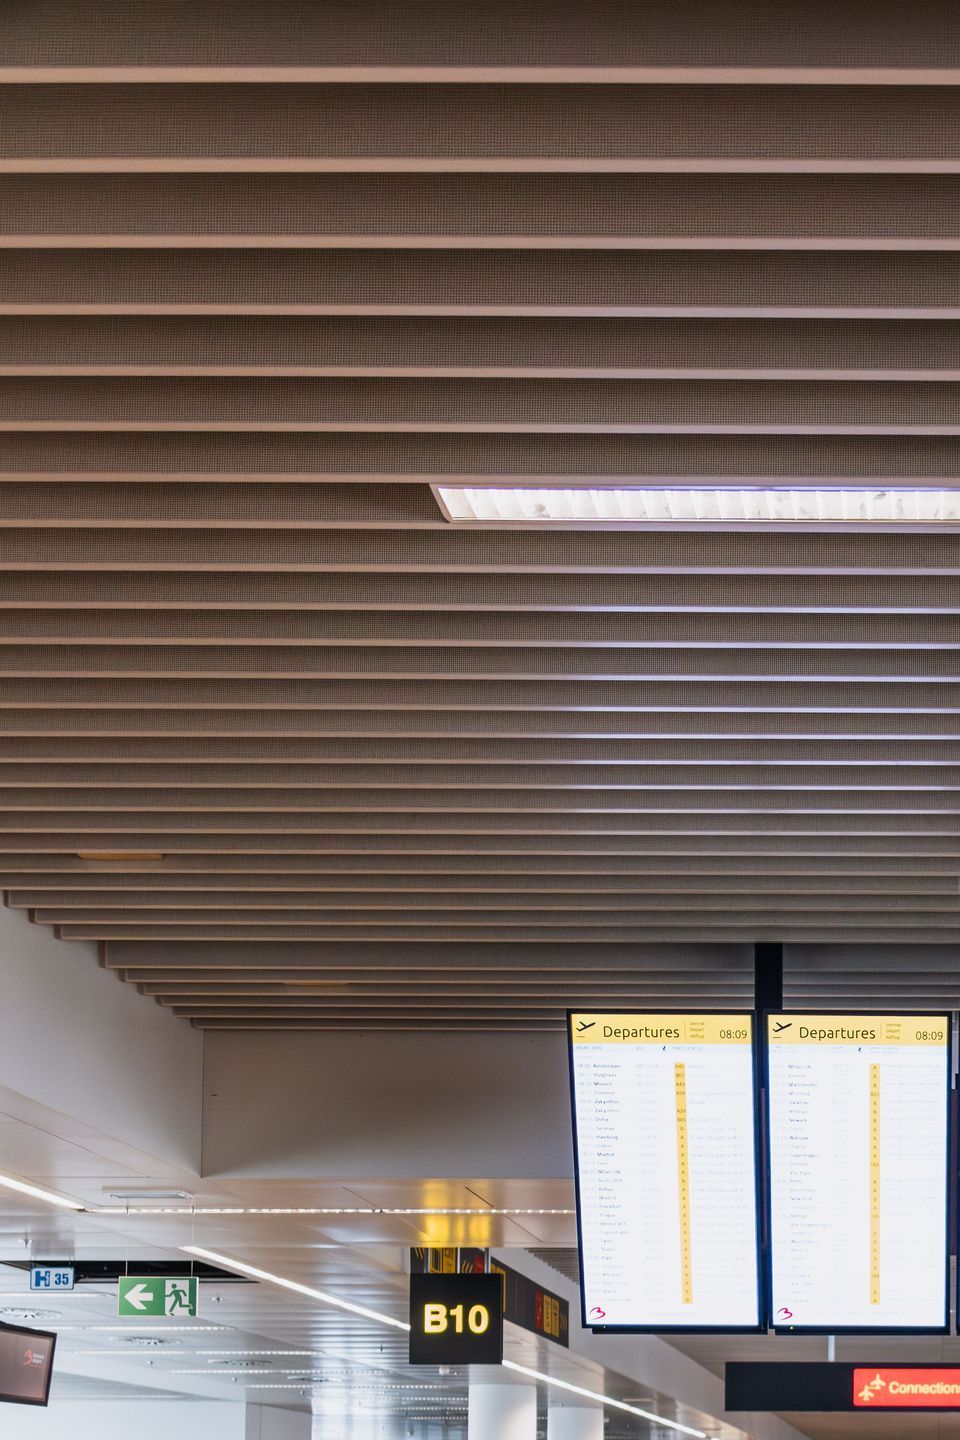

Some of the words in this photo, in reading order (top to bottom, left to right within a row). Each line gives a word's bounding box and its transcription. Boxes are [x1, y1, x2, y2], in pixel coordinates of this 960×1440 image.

[603, 1026, 680, 1040] Departures
[720, 1030, 748, 1039] 08:09
[799, 1027, 876, 1041] Departures
[916, 1031, 943, 1040] 08:09
[54, 1273, 69, 1285] 35
[424, 1304, 489, 1334] B10
